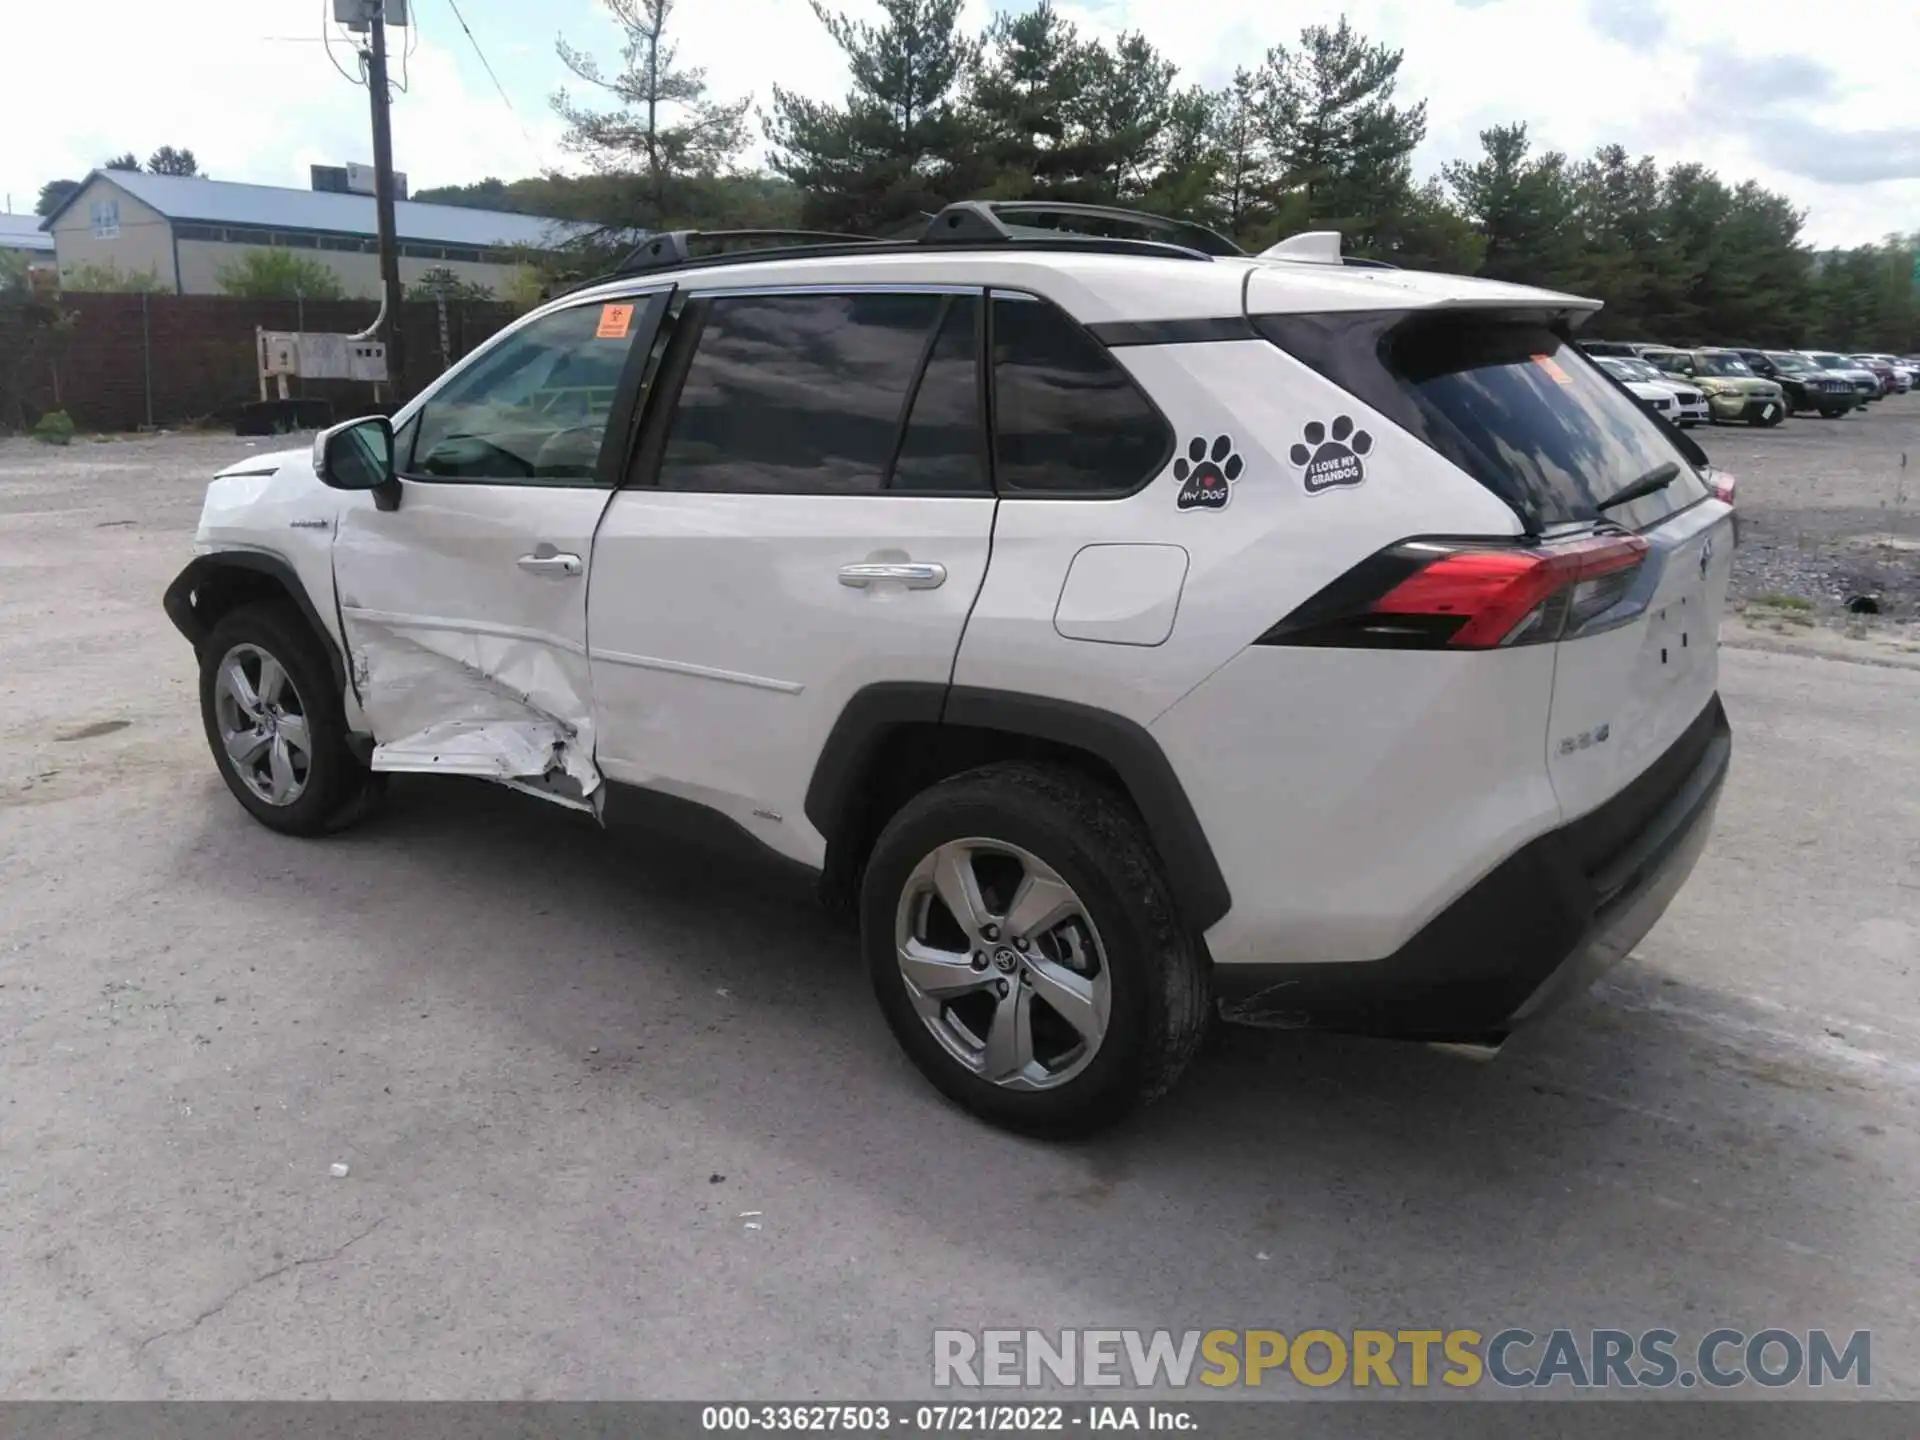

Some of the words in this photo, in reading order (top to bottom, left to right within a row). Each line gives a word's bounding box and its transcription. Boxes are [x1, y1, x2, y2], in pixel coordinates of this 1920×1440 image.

[1316, 458, 1340, 473] LOVE
[1341, 455, 1356, 468] MY
[1311, 466, 1359, 485] GRANDOG
[1201, 487, 1227, 500] DOG
